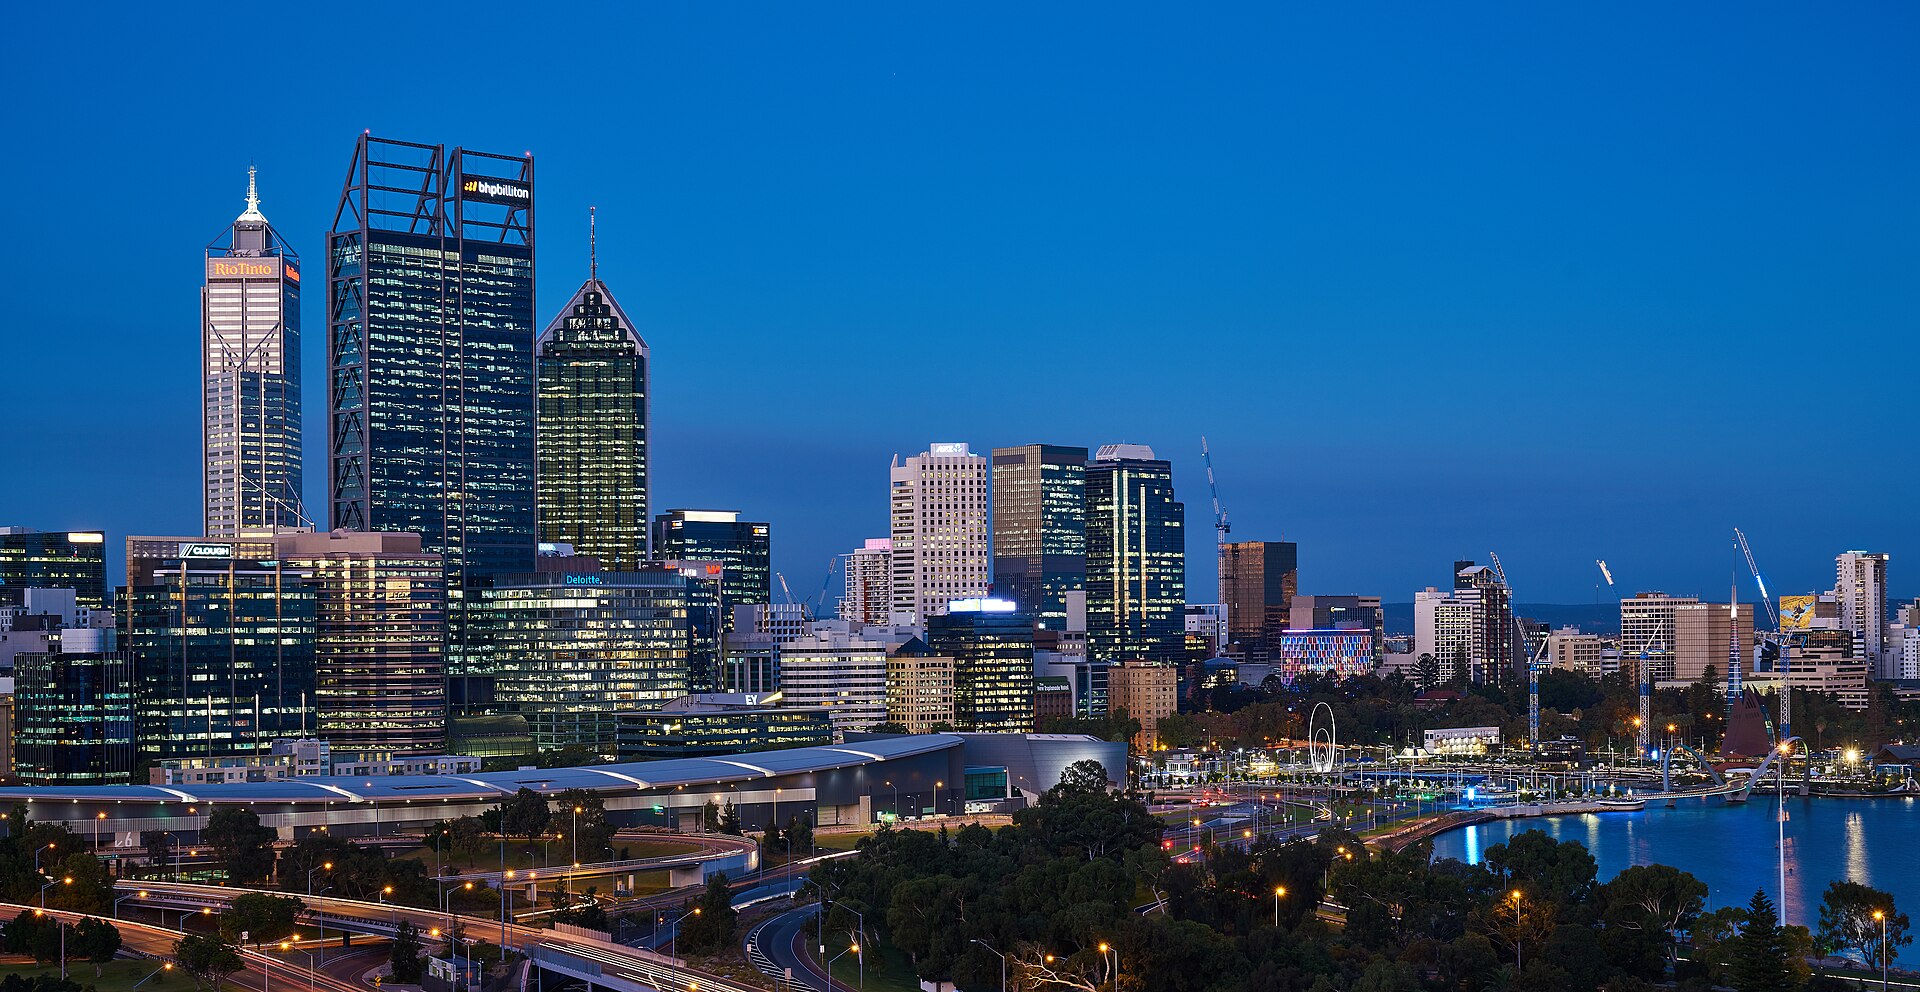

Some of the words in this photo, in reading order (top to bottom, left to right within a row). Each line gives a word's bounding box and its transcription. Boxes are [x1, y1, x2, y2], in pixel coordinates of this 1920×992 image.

[478, 181, 529, 199] bhpbilliton
[193, 546, 229, 555] CLOUGH
[745, 694, 758, 705] EY
[125, 831, 133, 847] 6
